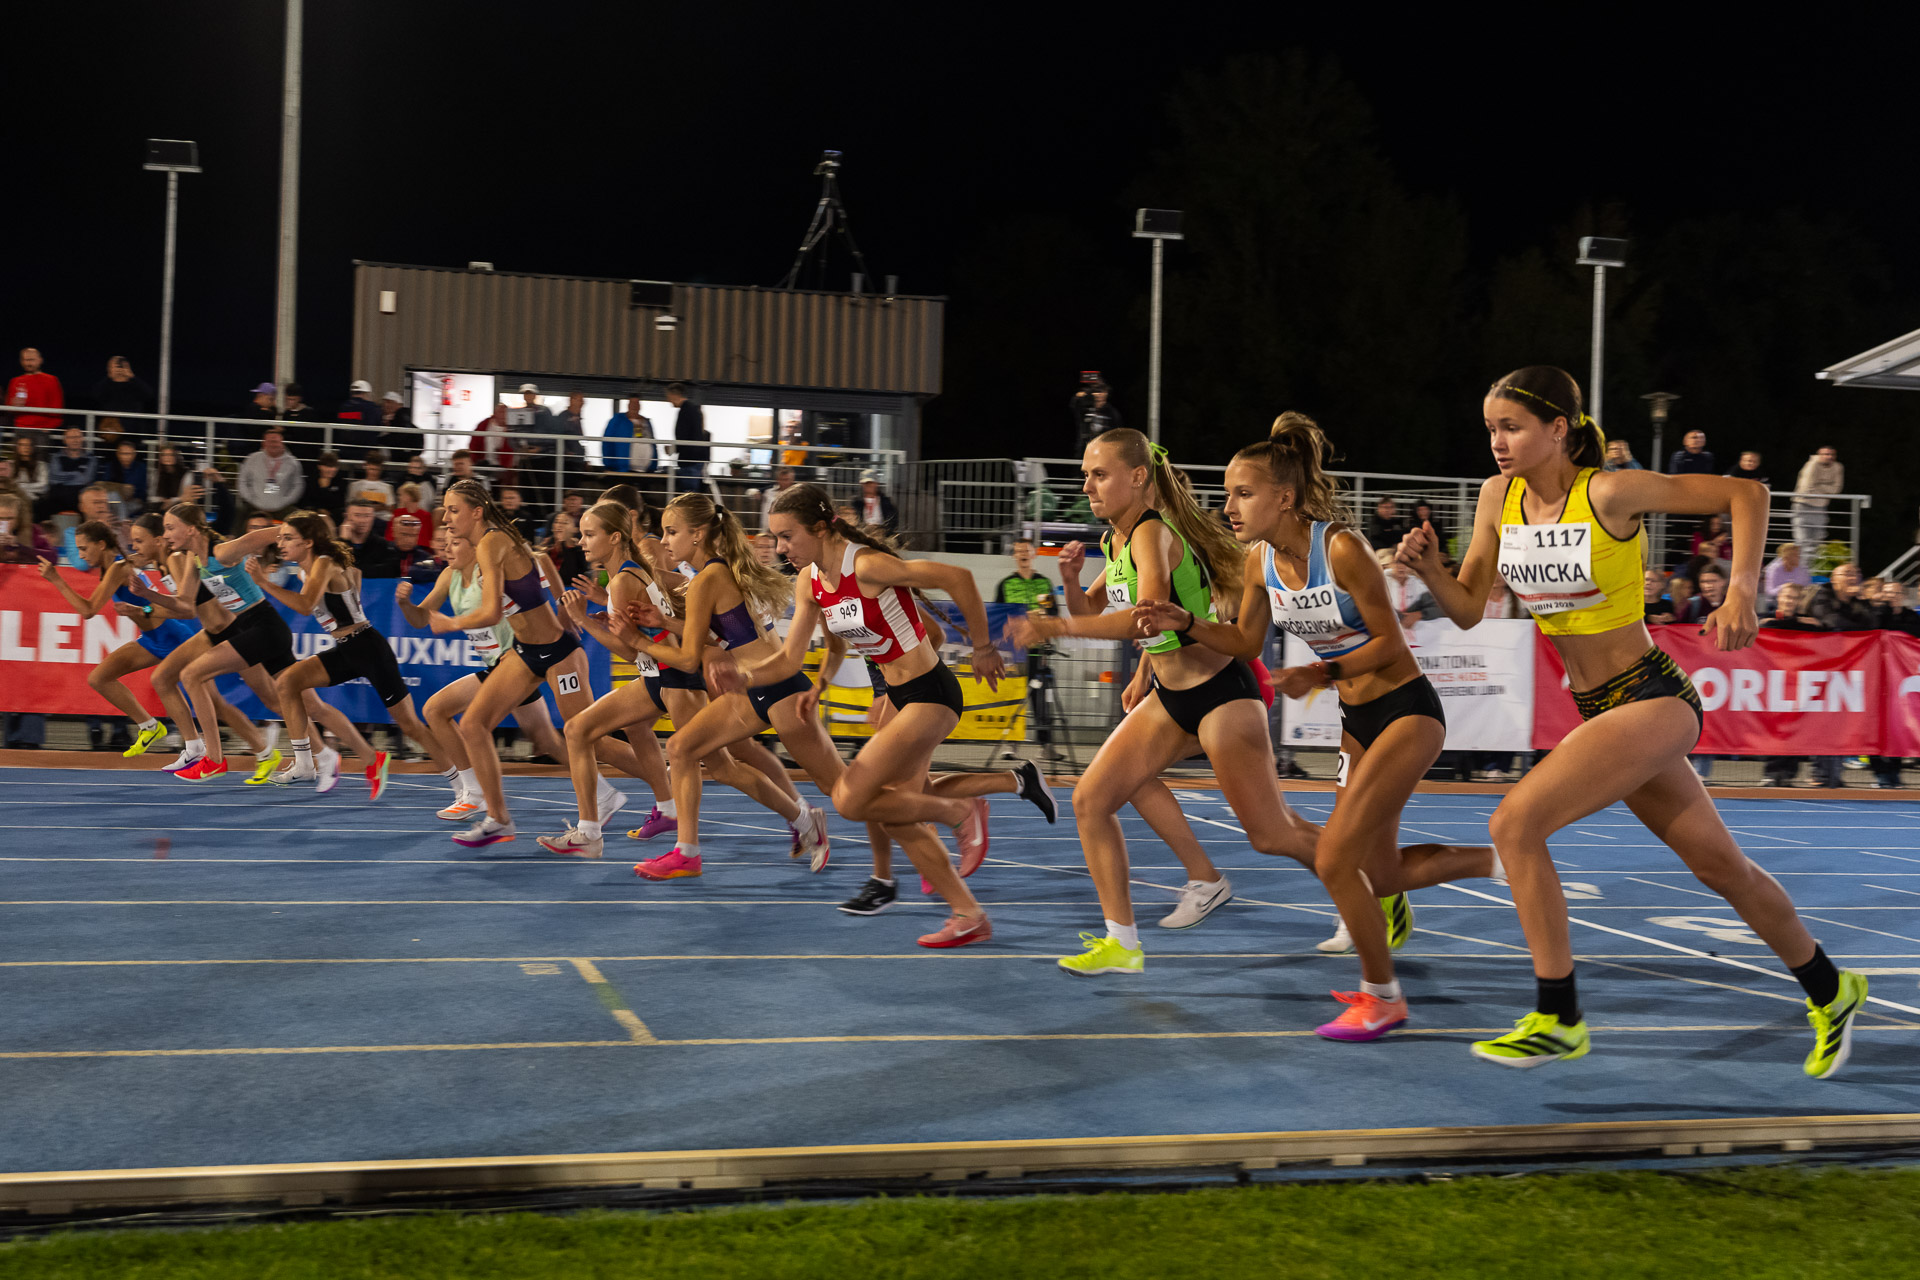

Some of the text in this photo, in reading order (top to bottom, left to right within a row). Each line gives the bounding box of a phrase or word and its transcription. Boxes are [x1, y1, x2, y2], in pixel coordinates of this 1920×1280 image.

[1534, 528, 1587, 548] 1117
[1500, 562, 1588, 583] PAWICKA
[1291, 589, 1333, 610] 1210
[1531, 602, 1553, 611] UBIN
[839, 603, 858, 620] 949
[559, 675, 579, 691] 10
[1690, 666, 1866, 713] ORLEN
